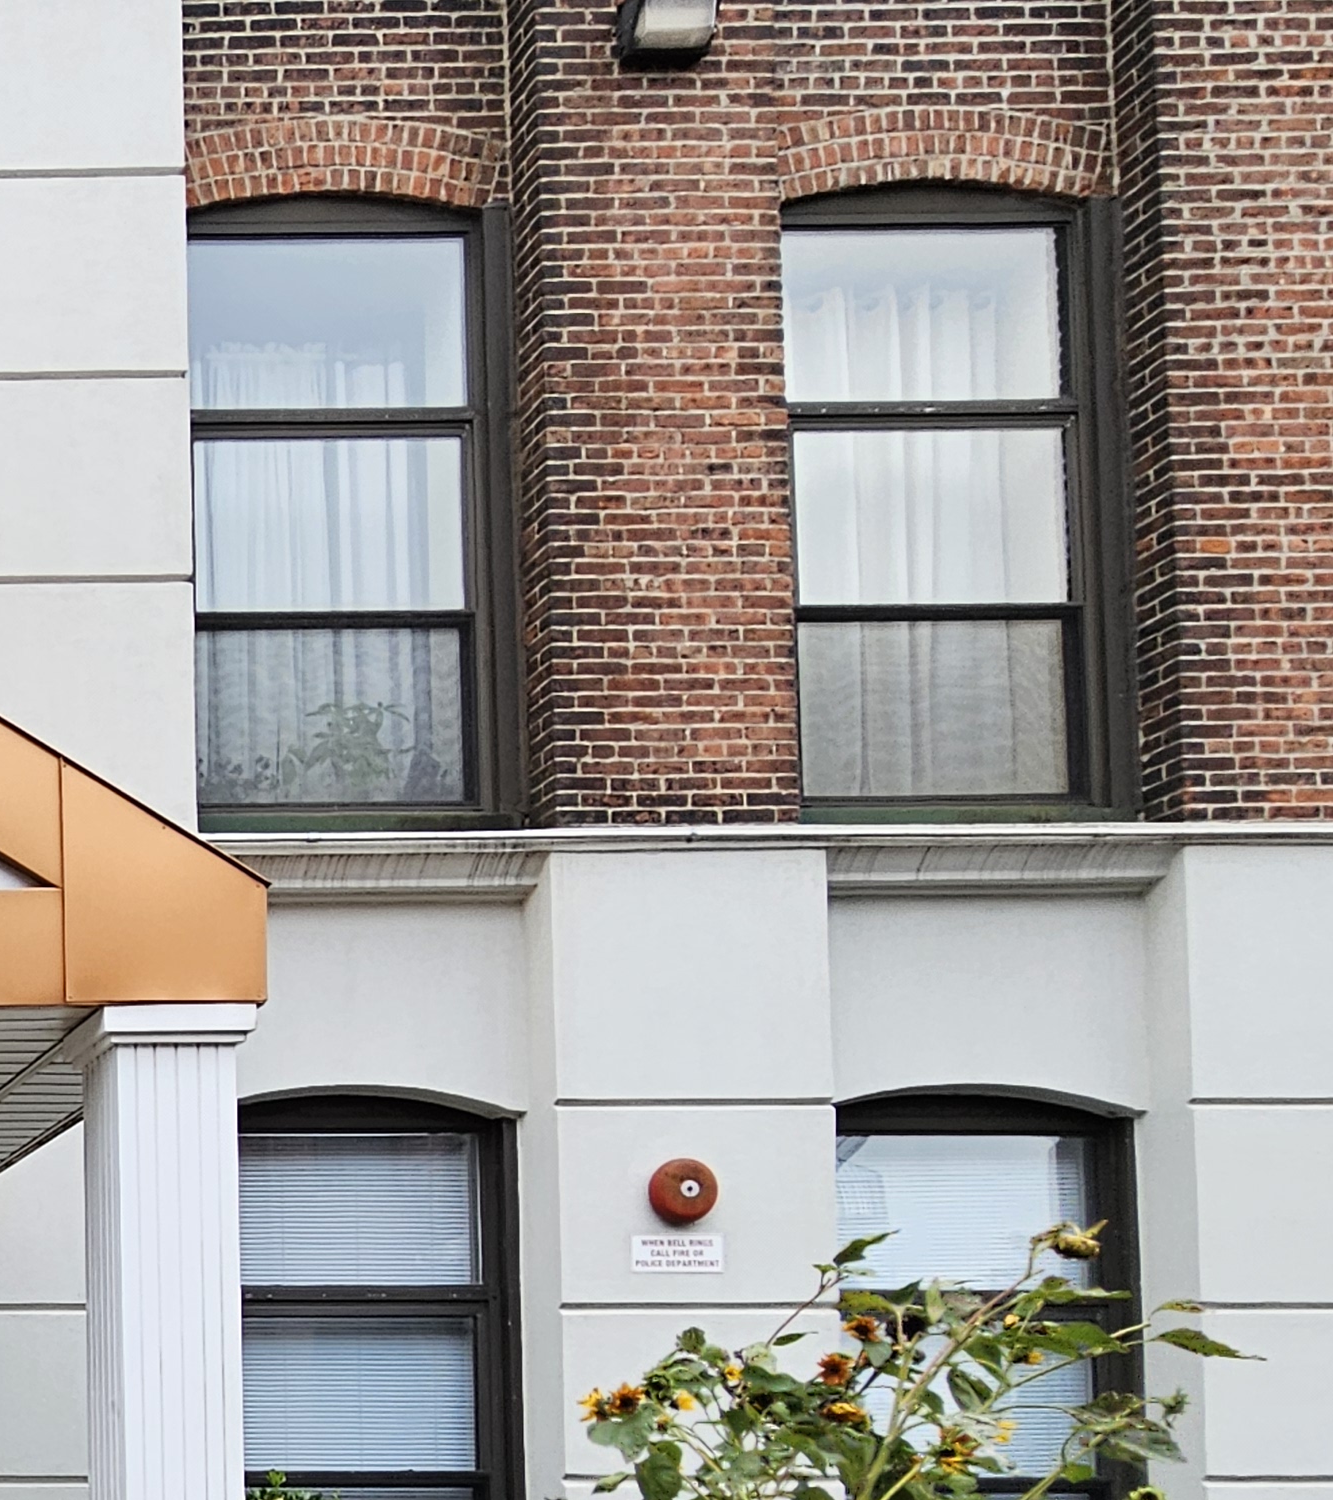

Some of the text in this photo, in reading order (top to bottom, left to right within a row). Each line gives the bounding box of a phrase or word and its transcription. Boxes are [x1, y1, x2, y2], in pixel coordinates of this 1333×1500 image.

[641, 1239, 714, 1247] WHEN BELL RINGS
[650, 1249, 704, 1257] CALL FIRE OR
[635, 1259, 720, 1267] POLICE DEPARTMENT
